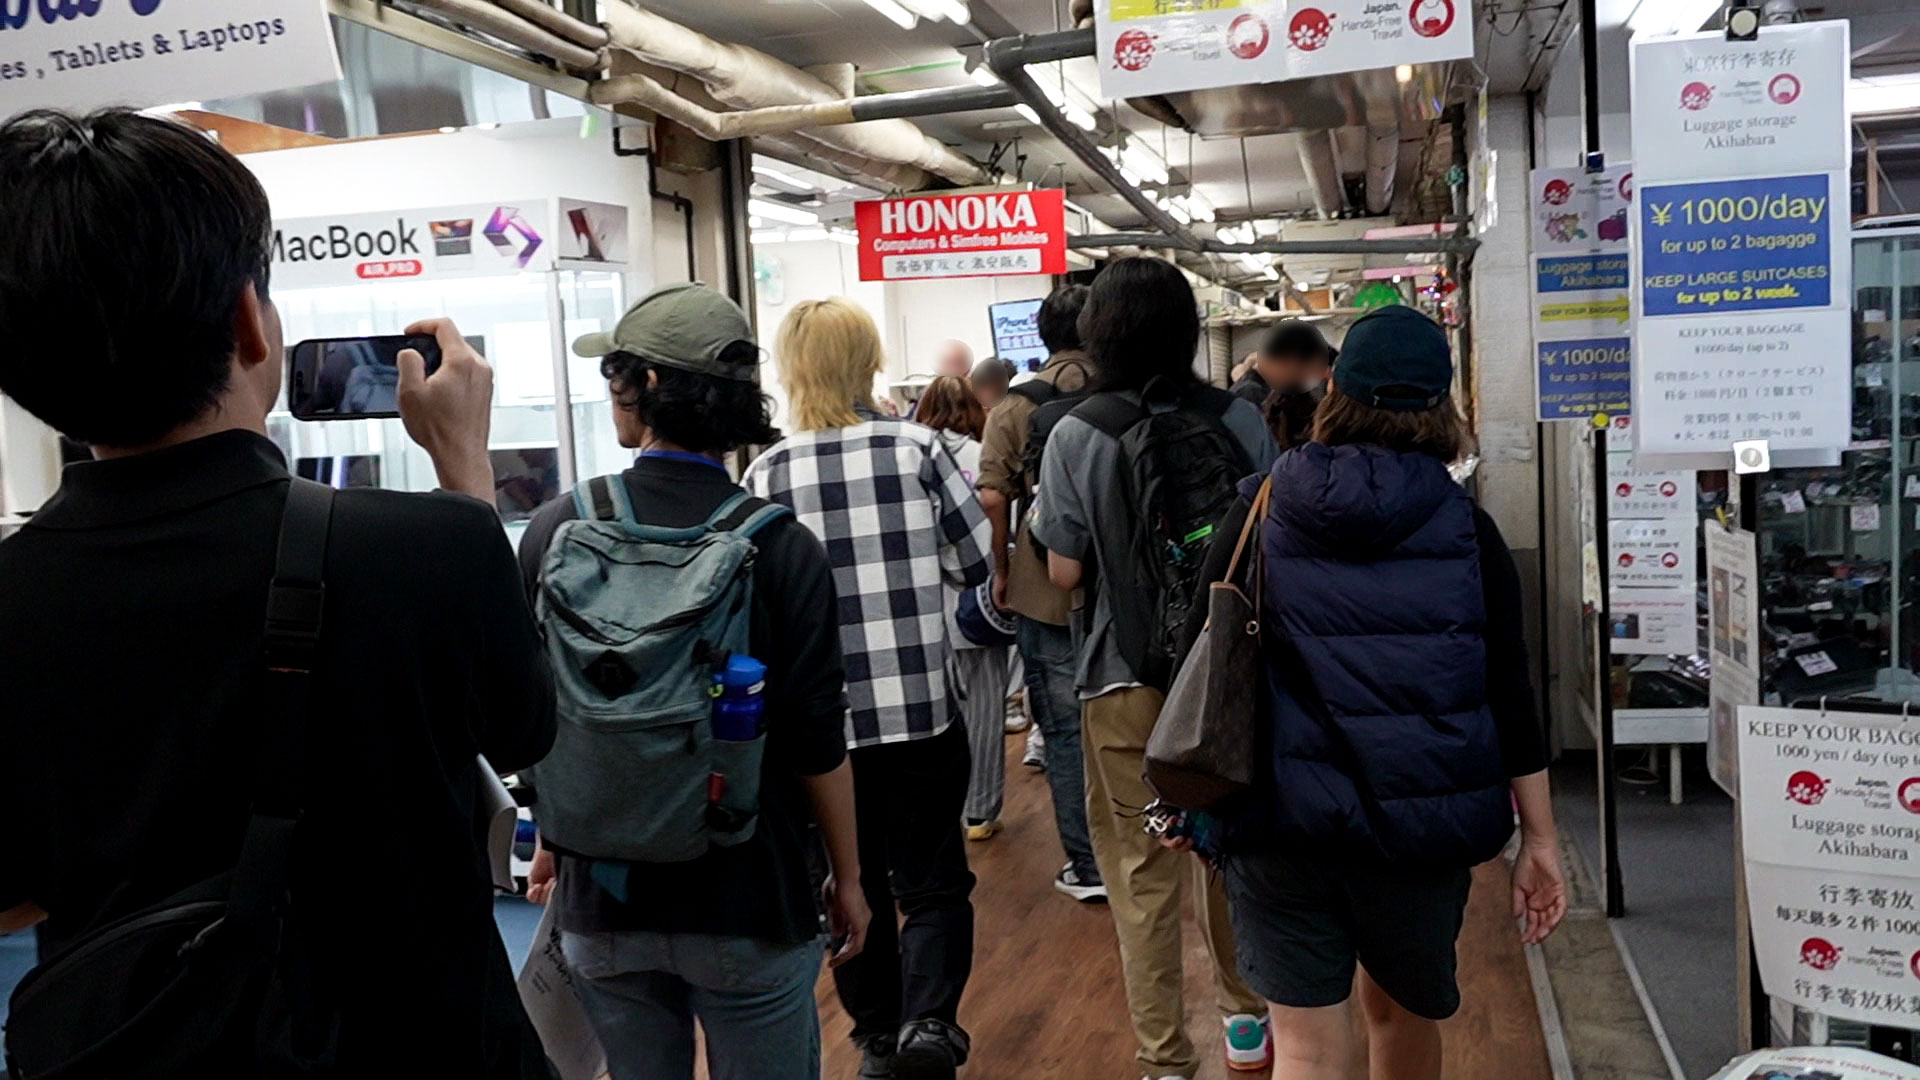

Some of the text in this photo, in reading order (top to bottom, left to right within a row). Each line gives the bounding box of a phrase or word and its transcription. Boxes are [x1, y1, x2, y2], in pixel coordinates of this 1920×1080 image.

[48, 41, 144, 71] Tablets
[153, 34, 172, 54] &
[179, 18, 285, 52] Laptops
[1684, 114, 1797, 133] Luggage storage
[1704, 133, 1775, 149] Akihabara
[881, 194, 1037, 234] HONOKA
[1650, 193, 1826, 226] ¥ 1000/day
[874, 237, 936, 252] Computers
[938, 235, 949, 248] &
[1000, 231, 1048, 245] Mobiles
[1661, 240, 1683, 253] for
[1687, 240, 1707, 254] up
[1712, 237, 1727, 250] to
[1731, 235, 1741, 249] 2
[1645, 265, 1828, 289] KEEP LARGE SUITCASES
[1677, 291, 1695, 304] for
[1700, 290, 1720, 305] up
[1724, 288, 1740, 301] to
[1743, 286, 1753, 300] 2
[1748, 721, 1798, 738] KEEP
[1803, 724, 1861, 743] YOUR
[1776, 744, 1809, 758] 1000
[1814, 749, 1839, 763] yen
[1853, 749, 1879, 766] day
[1883, 752, 1909, 768] (up
[1791, 814, 1866, 838] Luggage
[1818, 839, 1909, 861] Akihabara
